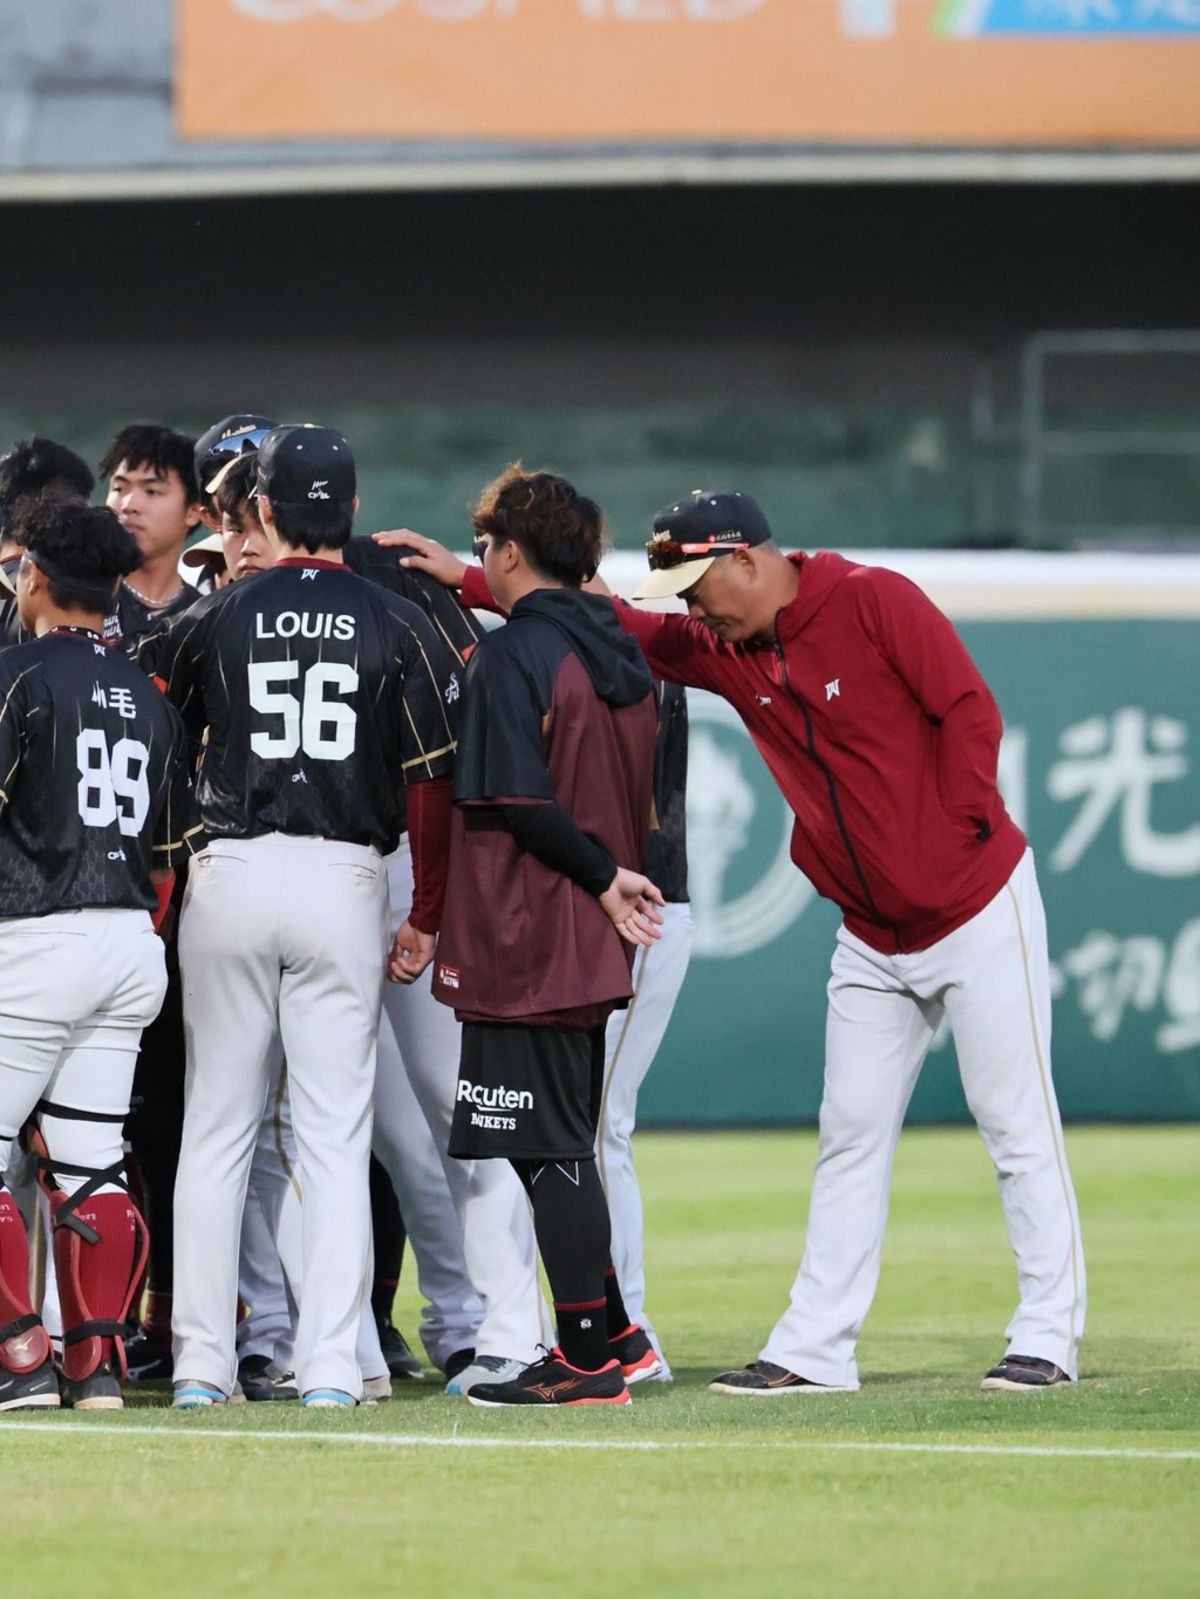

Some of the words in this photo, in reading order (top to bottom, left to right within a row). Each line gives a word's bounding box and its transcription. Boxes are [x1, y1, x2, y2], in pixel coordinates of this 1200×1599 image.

[256, 611, 356, 641] LOUIS
[91, 681, 137, 719] 小毛
[247, 660, 359, 761] 56
[76, 727, 151, 838] 89
